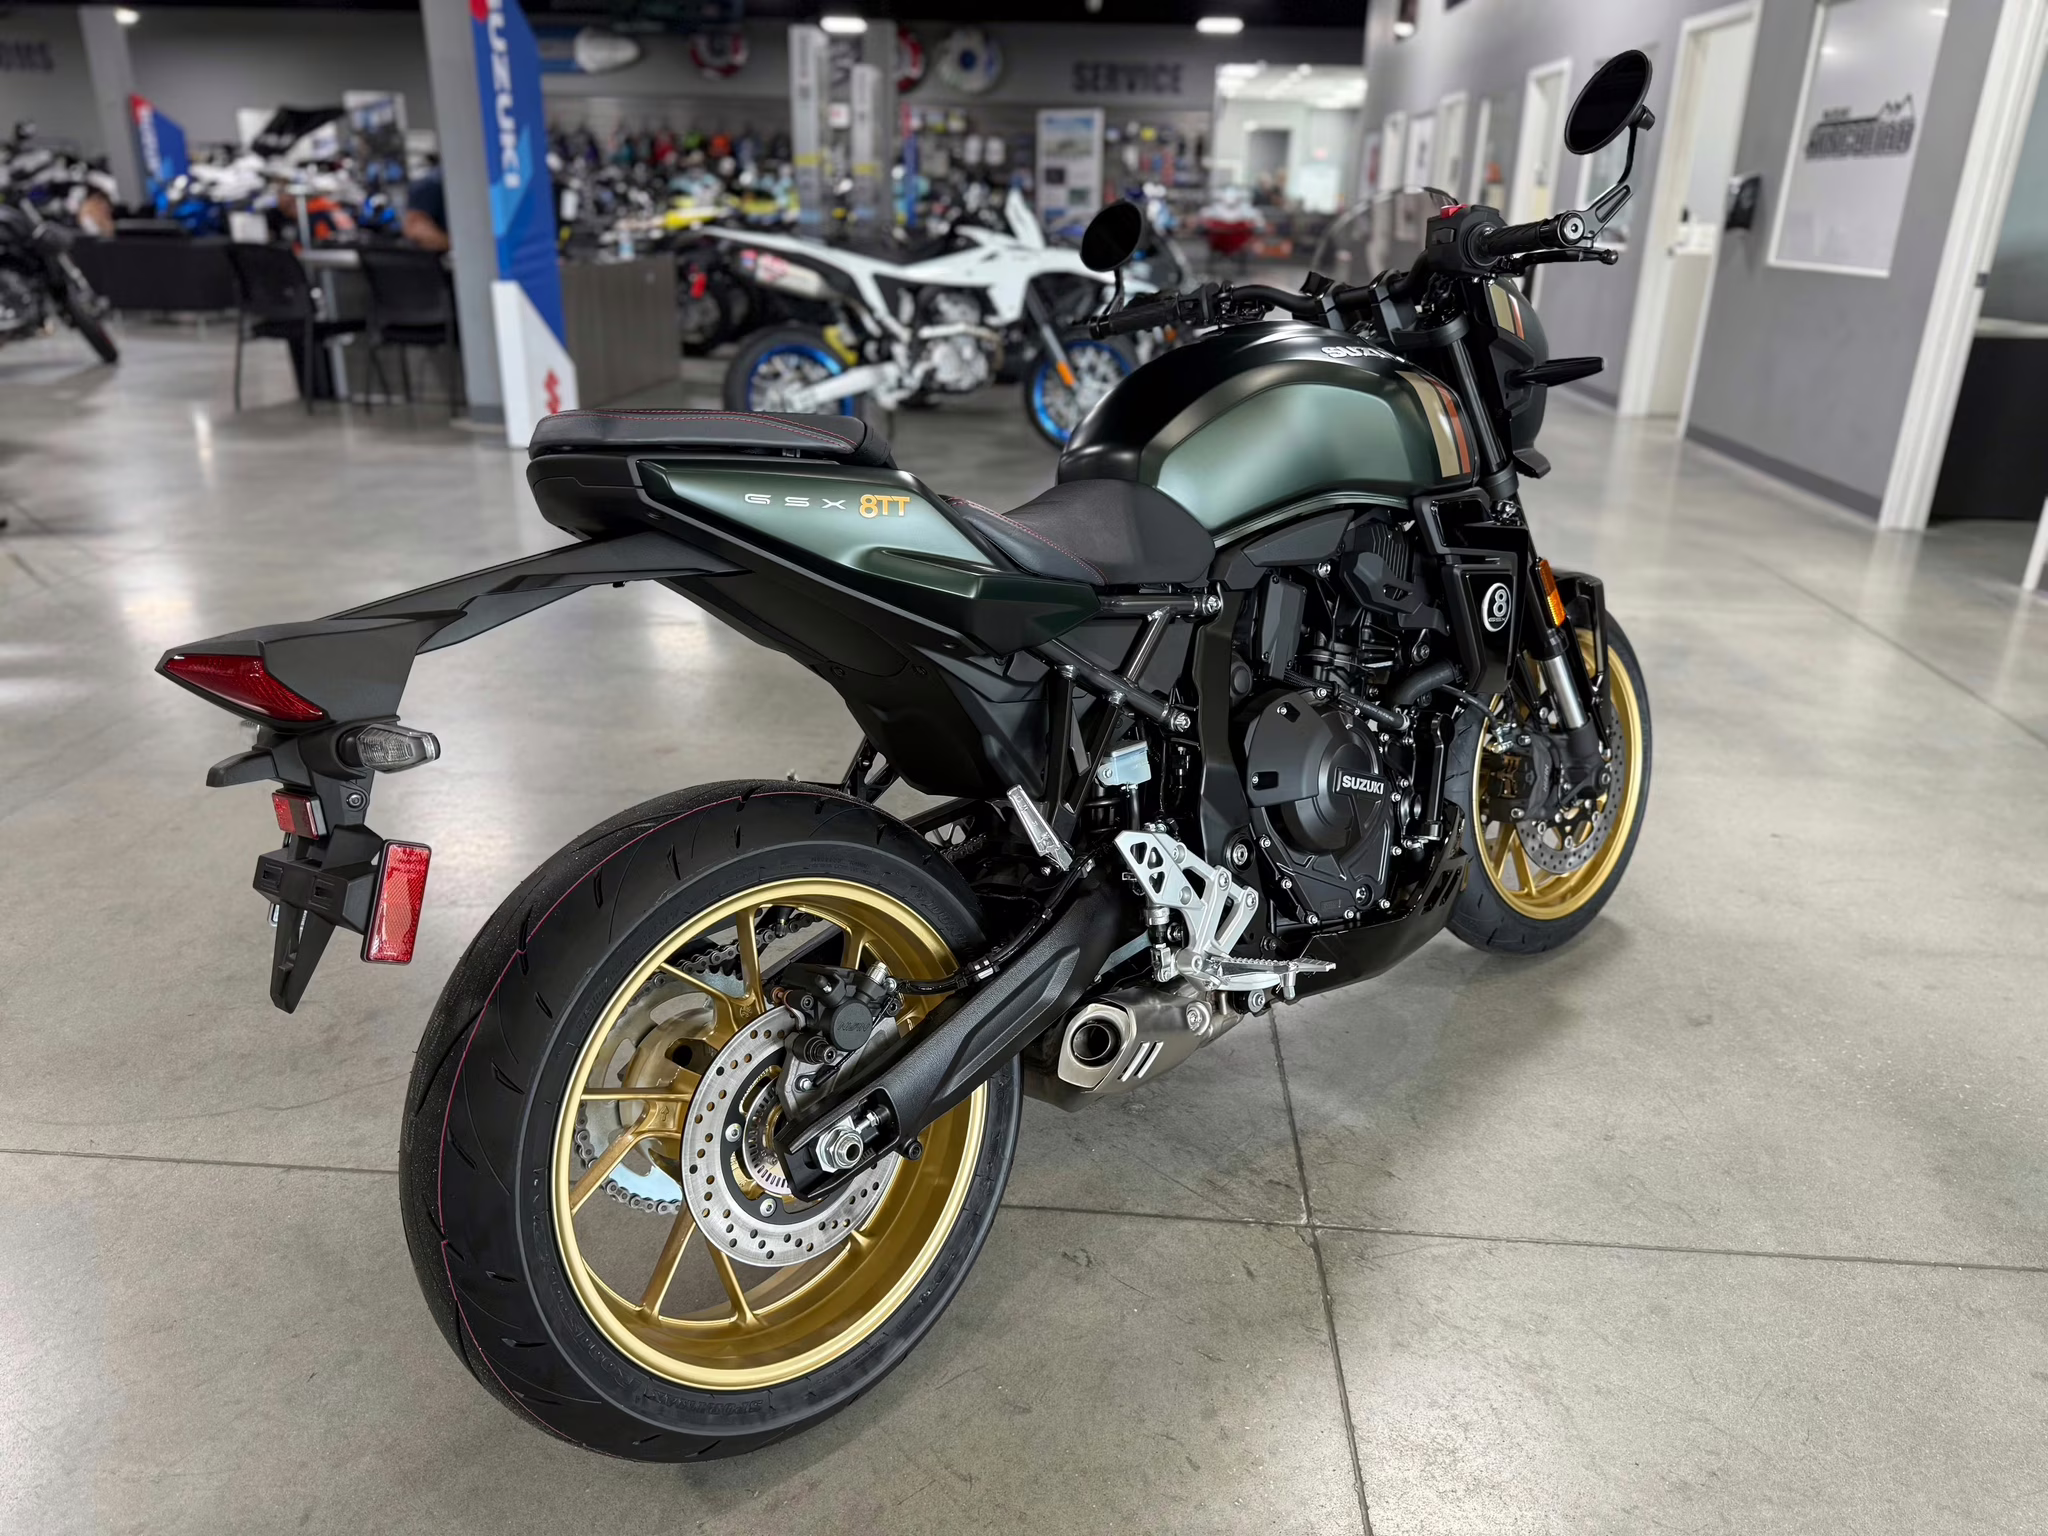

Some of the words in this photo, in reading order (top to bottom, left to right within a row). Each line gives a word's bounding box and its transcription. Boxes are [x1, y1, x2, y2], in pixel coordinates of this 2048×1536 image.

[859, 493, 911, 519] 8TT
[1493, 589, 1508, 617] 8
[1342, 775, 1385, 795] SUZUKI
